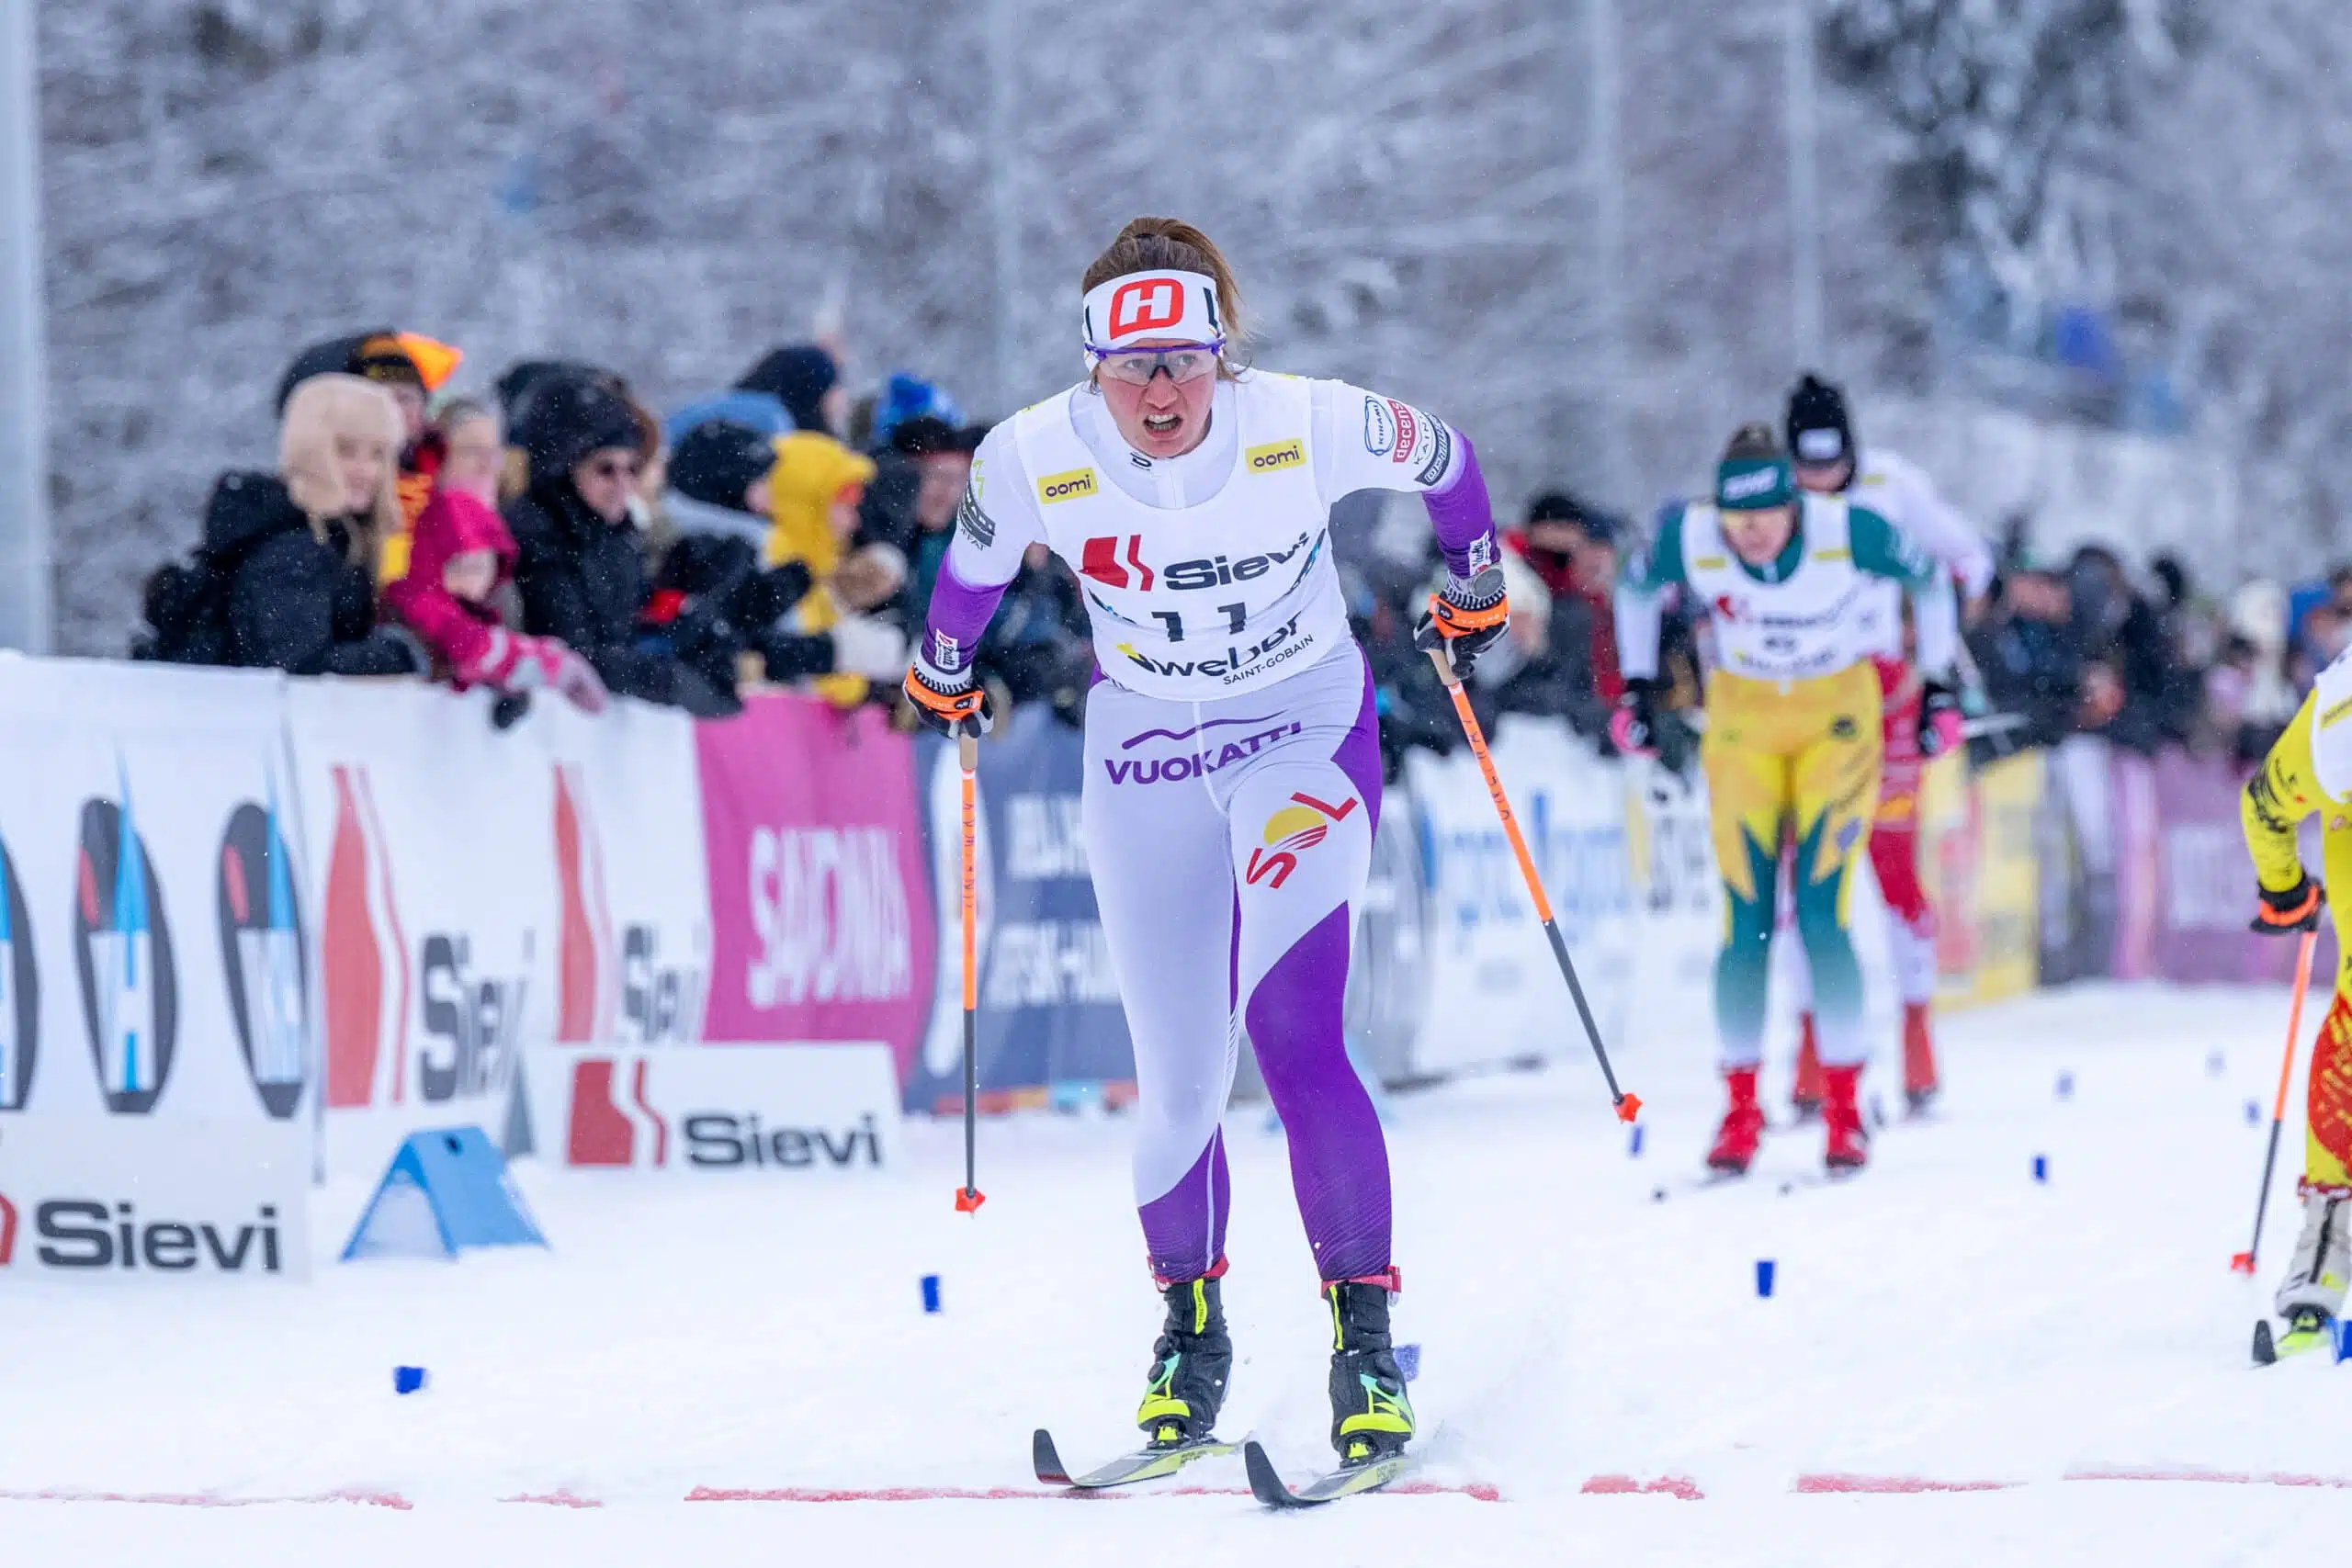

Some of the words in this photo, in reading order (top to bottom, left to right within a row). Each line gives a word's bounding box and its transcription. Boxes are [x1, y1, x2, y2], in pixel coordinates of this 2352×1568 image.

[1045, 474, 1091, 498] oomi
[1253, 445, 1300, 468] oomi
[1163, 531, 1310, 591] Sievi
[1147, 610, 1303, 678] weber
[1223, 633, 1315, 686] SAINT-GOBAIN
[1103, 720, 1302, 785] VUOKATTI
[683, 1113, 882, 1171] Sievi
[35, 1201, 280, 1277] Sievi
